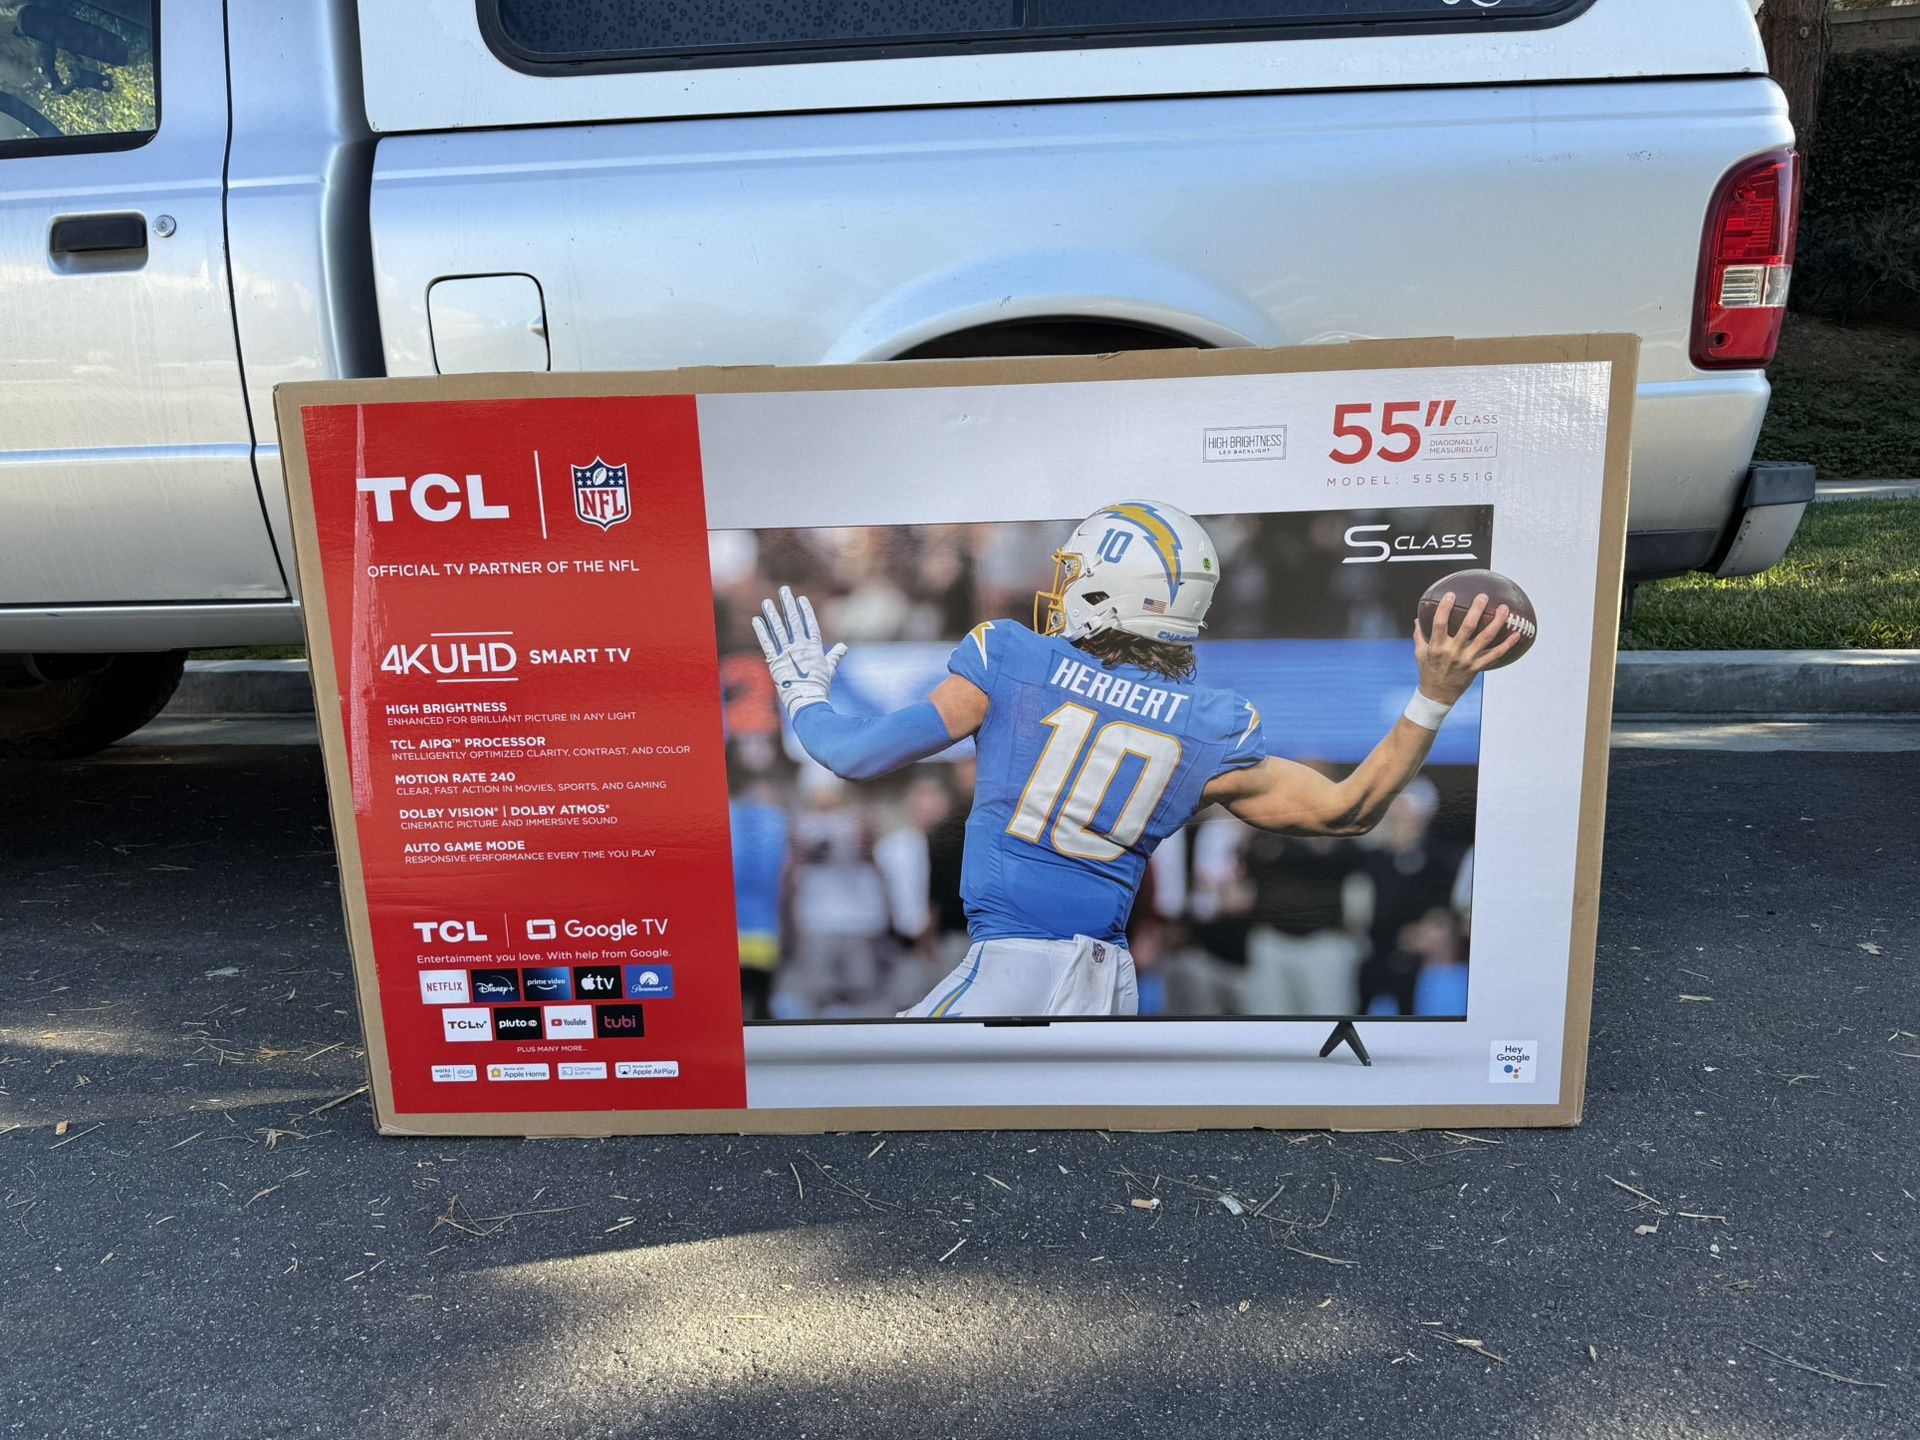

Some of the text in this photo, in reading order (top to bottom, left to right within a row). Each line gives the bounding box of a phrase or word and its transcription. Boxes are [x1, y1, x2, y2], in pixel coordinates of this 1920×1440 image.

[1454, 414, 1499, 426] CLASS
[1208, 434, 1282, 449] HIGH BRIGHTNESS
[1429, 439, 1480, 447] DIAGONALLY
[1429, 446, 1471, 454] MEASURED
[1326, 472, 1493, 487] MODEL: 55S551G
[356, 473, 510, 522] TCL
[581, 489, 625, 520] NFL
[1096, 527, 1134, 564] 10
[1341, 524, 1473, 564] S CLASS
[367, 559, 639, 578] OFFICIAL TV PARTNER OF THE NFL
[529, 648, 598, 664] SMART
[604, 647, 631, 663] TV
[1050, 658, 1189, 723] HERBERT
[386, 702, 508, 715] HIGH BRIGHTNESS
[387, 711, 637, 726] ENHANCED FOR BRILLIANT PICTURE IN ANY LIGHT
[390, 739, 416, 751] TCL
[464, 736, 546, 748] PROCESSOR
[391, 745, 691, 761] INTELLIGENTLY OPTIMIZED CLARITY, CONTRAST, AND COLOR
[395, 772, 516, 785] MOTION RATE 240
[1005, 701, 1182, 861] 10
[396, 780, 667, 796] CLEAR, FAST ACTION IN MOVIES, SPORTS, AND GAMING
[400, 808, 444, 819] DOLBY
[510, 805, 555, 816] DOLBY
[400, 816, 618, 830] CINEMATIC PICTURE AND IMMERSIVE SOUND
[404, 840, 525, 853] AUTO GAME MODE
[405, 849, 656, 864] RESPONSIVE PERFORMANCE EVERY TIME YOU PLAY
[413, 920, 488, 943] TCL
[564, 919, 668, 941] Google TV
[417, 948, 671, 964] Entertainment you love. With help from Google.
[426, 981, 463, 993] NETFLIX
[527, 977, 566, 988] prime video
[499, 1018, 527, 1029] pluto
[563, 1018, 587, 1027] YouTube
[603, 1015, 636, 1029] tubi
[1504, 1045, 1523, 1054] Hey
[1496, 1053, 1531, 1063] Google
